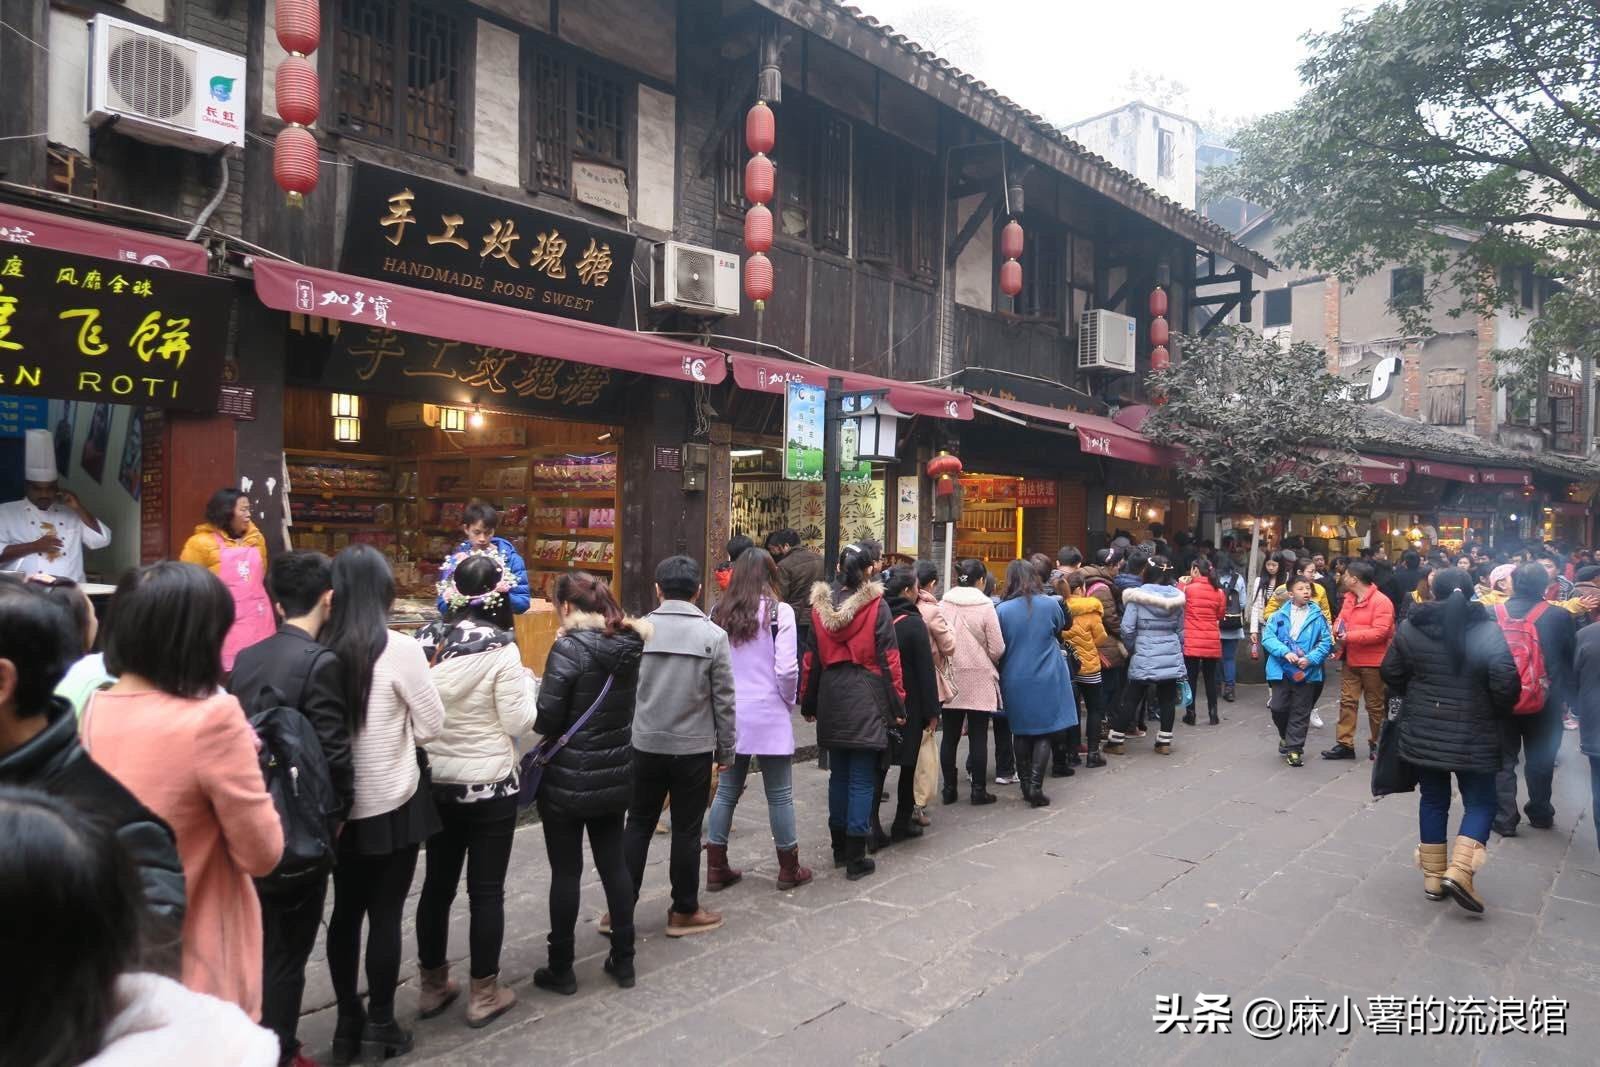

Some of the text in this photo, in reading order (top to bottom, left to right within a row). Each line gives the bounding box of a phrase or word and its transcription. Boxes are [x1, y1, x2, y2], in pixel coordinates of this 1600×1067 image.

[206, 106, 235, 122] 长虹
[379, 187, 614, 288] 手工玫瑰糖
[56, 267, 153, 298] 风靡全球
[383, 257, 594, 312] HANDMADE ROSE SWEET
[78, 371, 180, 399] ROTI
